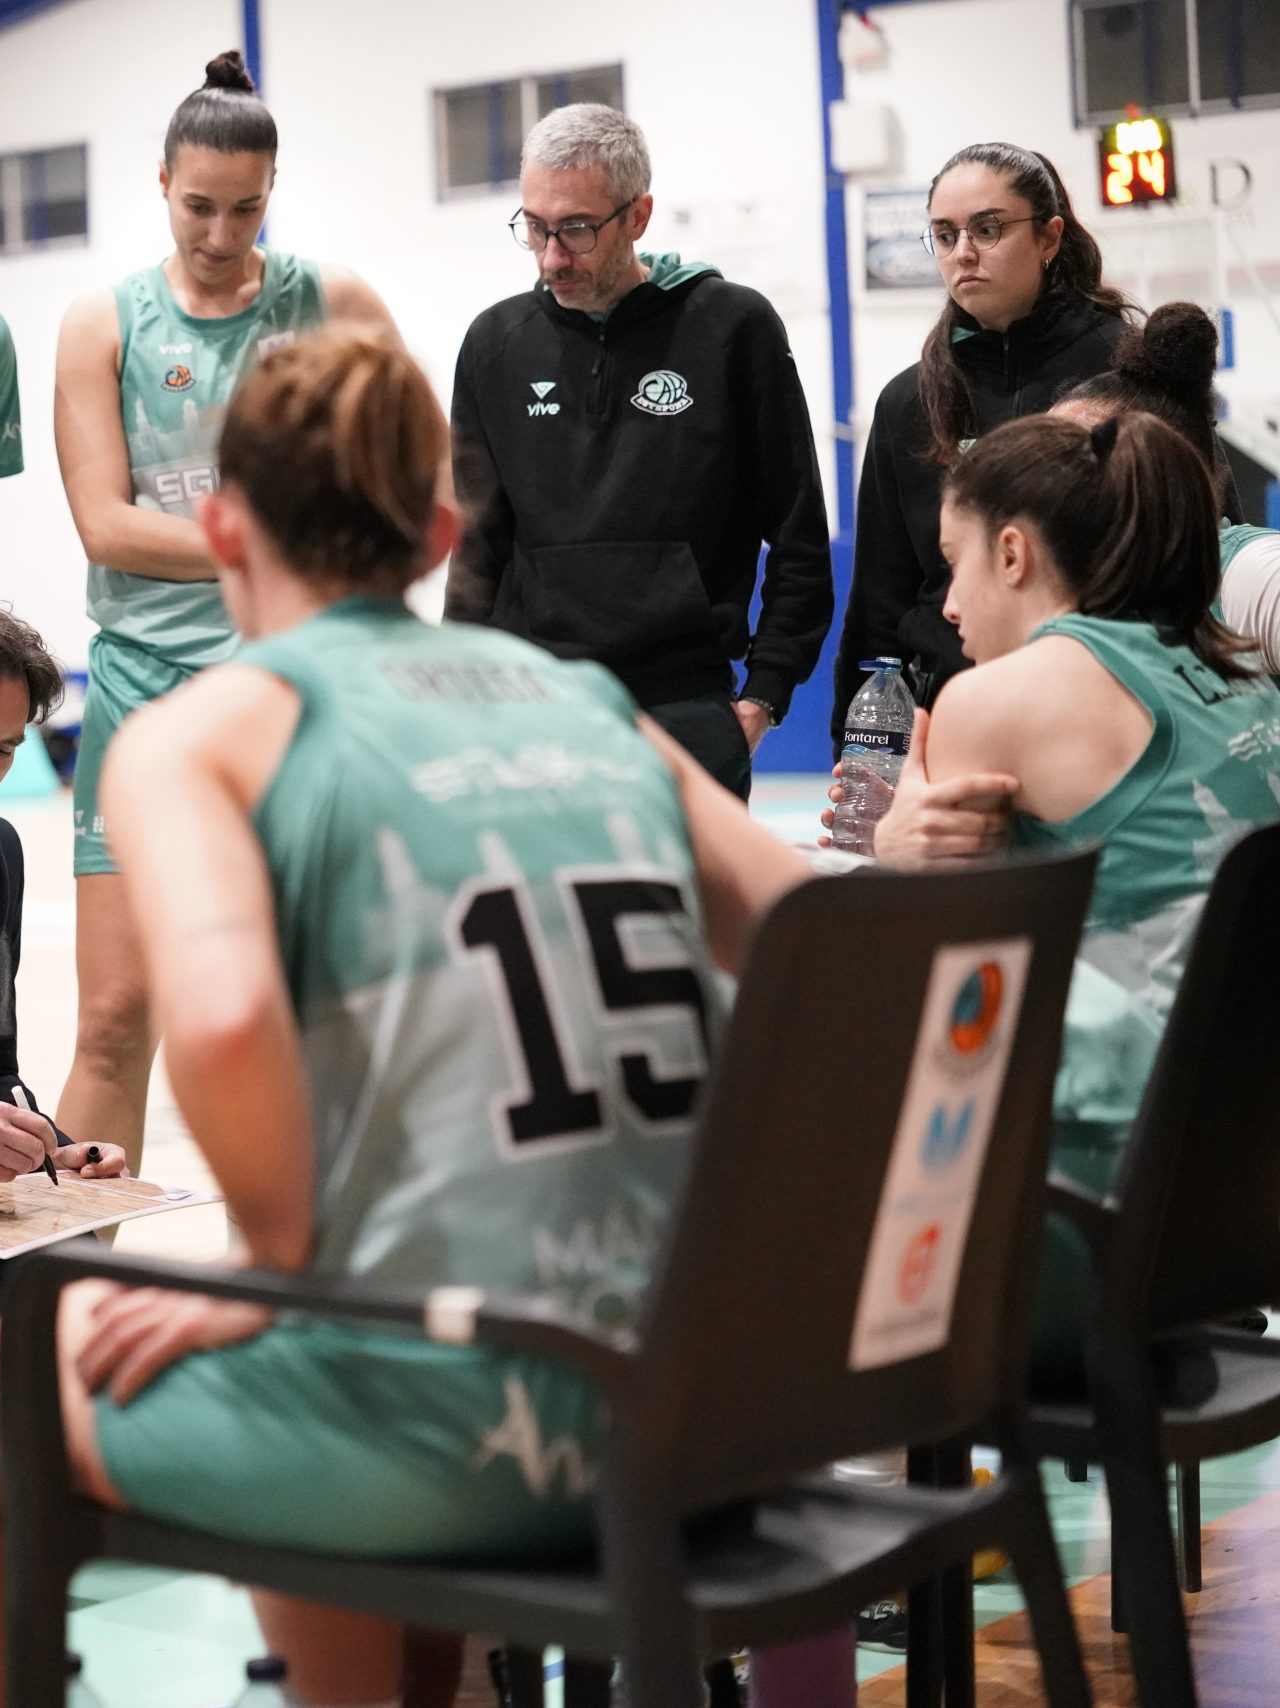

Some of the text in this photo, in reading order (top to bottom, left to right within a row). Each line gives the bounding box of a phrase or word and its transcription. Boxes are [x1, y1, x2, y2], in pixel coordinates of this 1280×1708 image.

[1106, 150, 1165, 204] 24
[527, 402, 561, 417] vive
[844, 731, 889, 745] Fontarel
[460, 880, 710, 1145] 15
